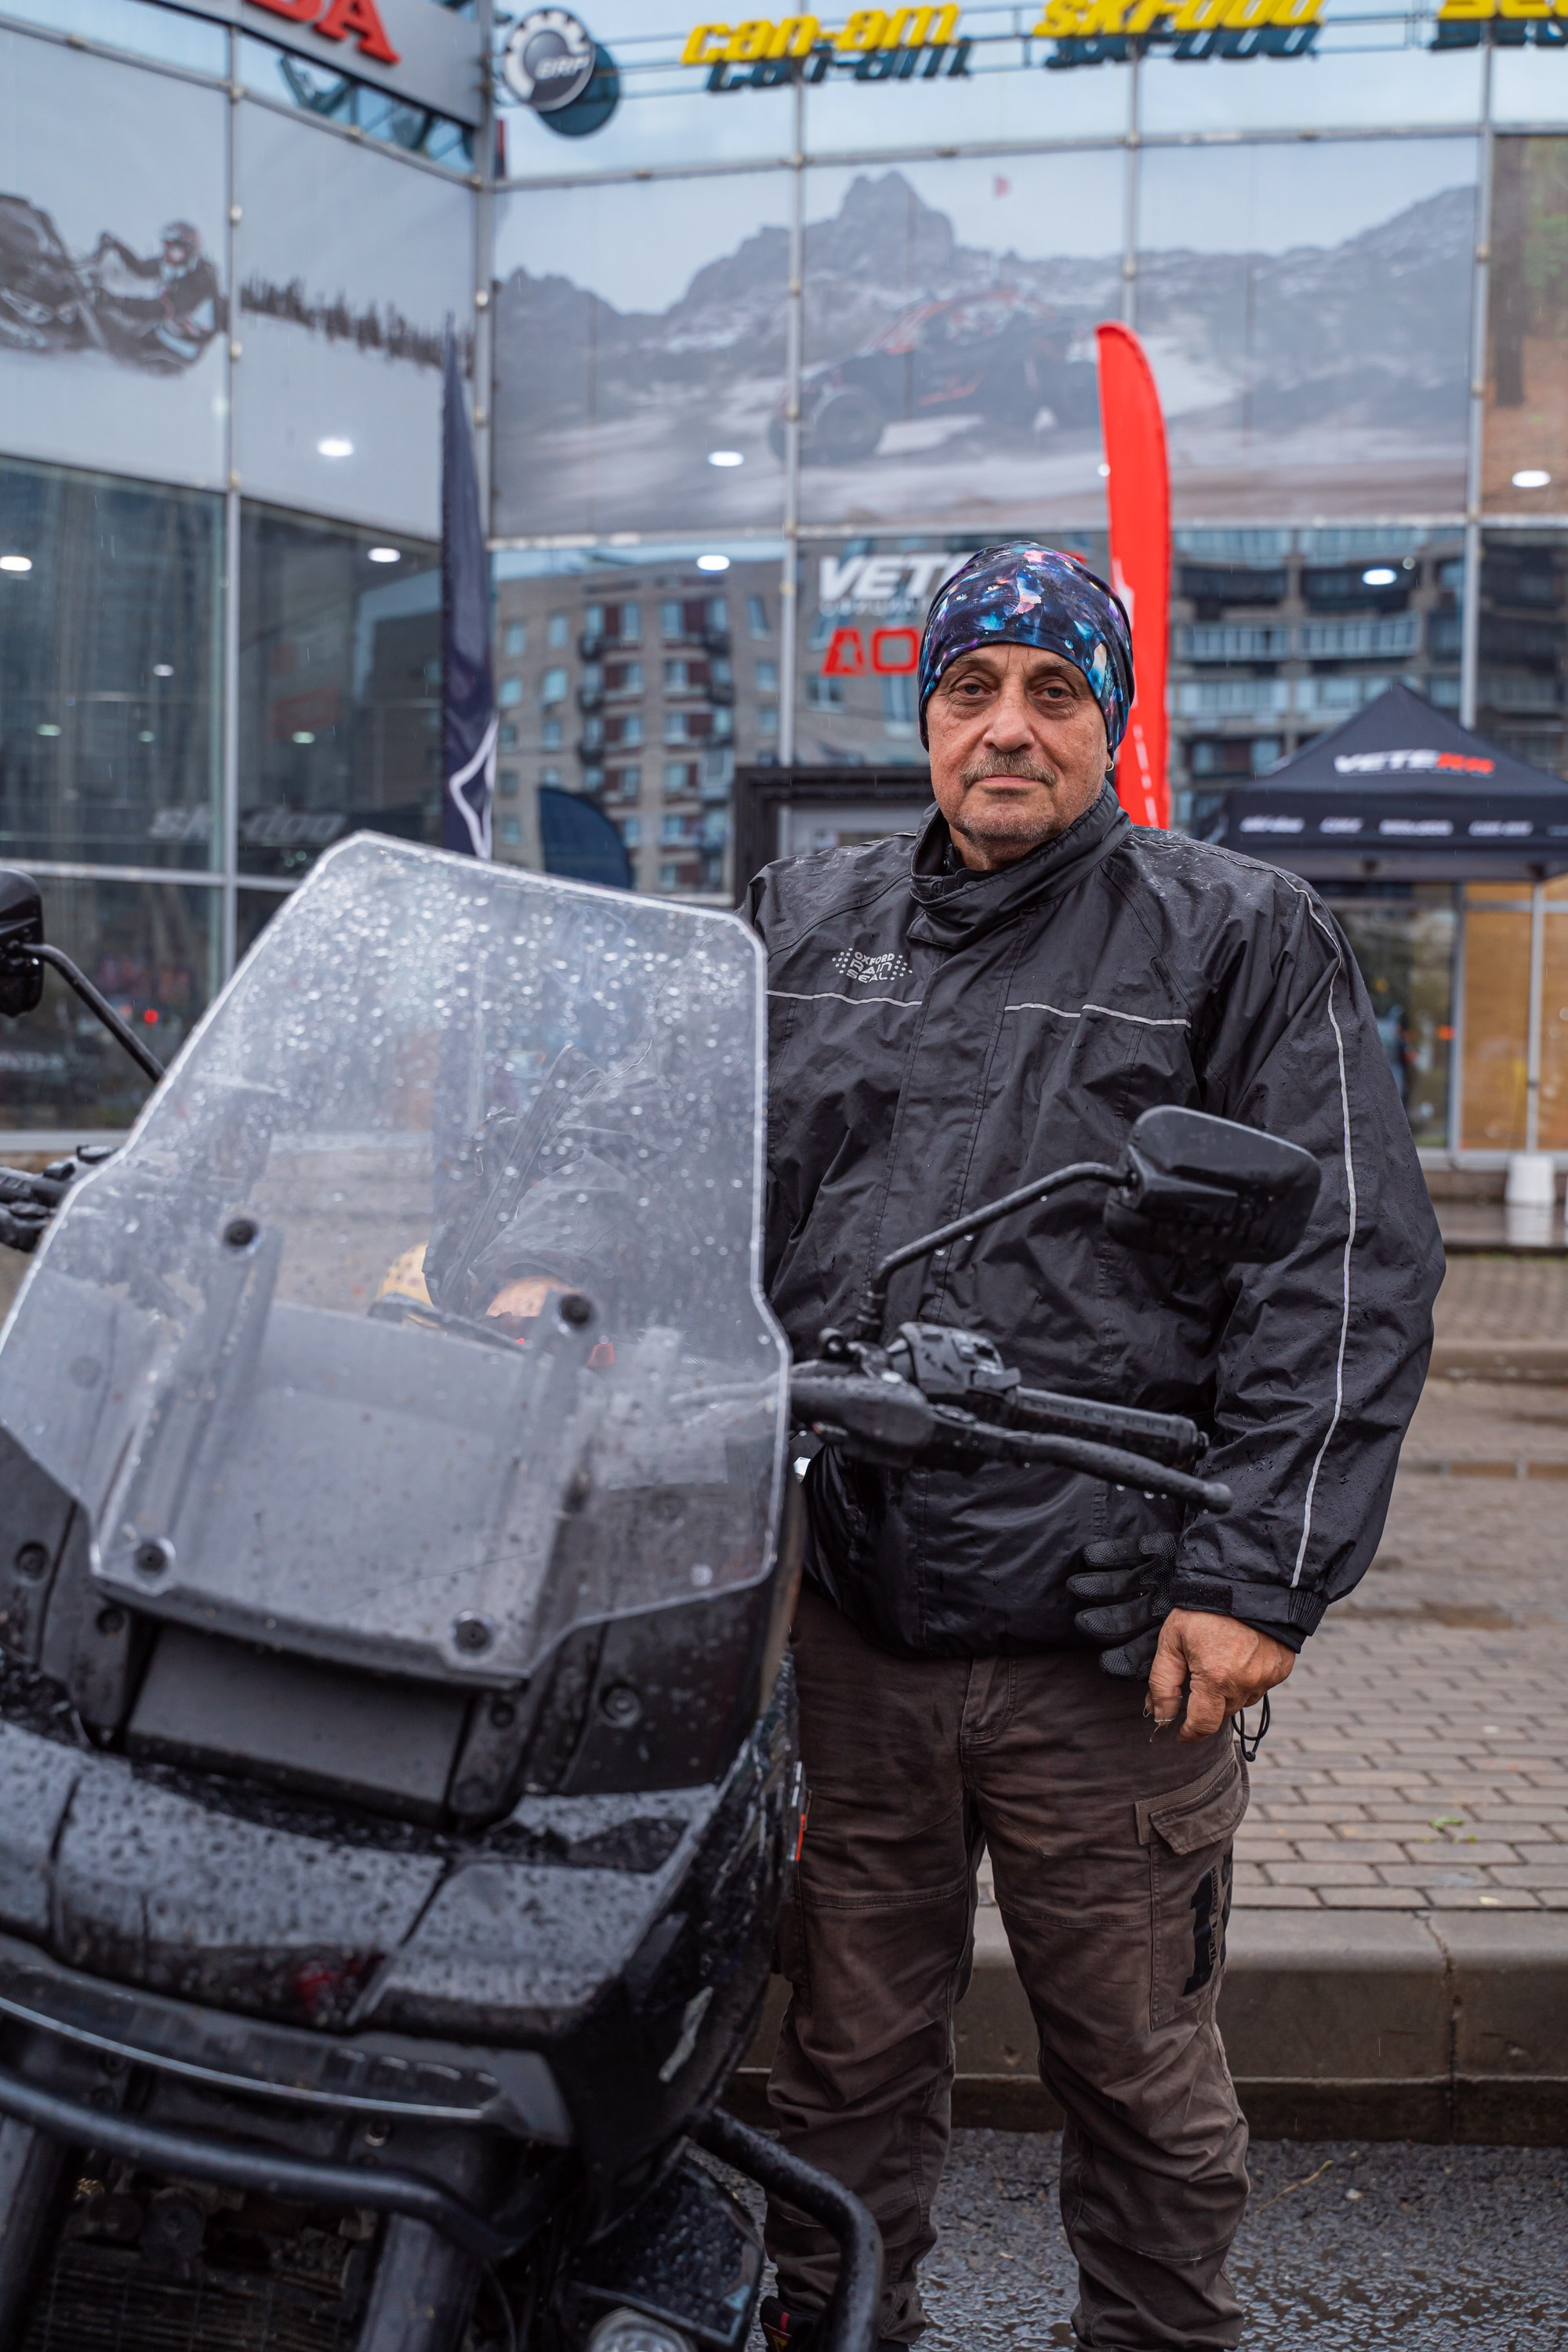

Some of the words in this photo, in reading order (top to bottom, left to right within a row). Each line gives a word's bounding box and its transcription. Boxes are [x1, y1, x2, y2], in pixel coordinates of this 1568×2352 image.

[821, 626, 920, 677] AO
[854, 951, 895, 965] OXFORD
[846, 968, 888, 983] SEAL
[1210, 1864, 1220, 1916] PREMIUM
